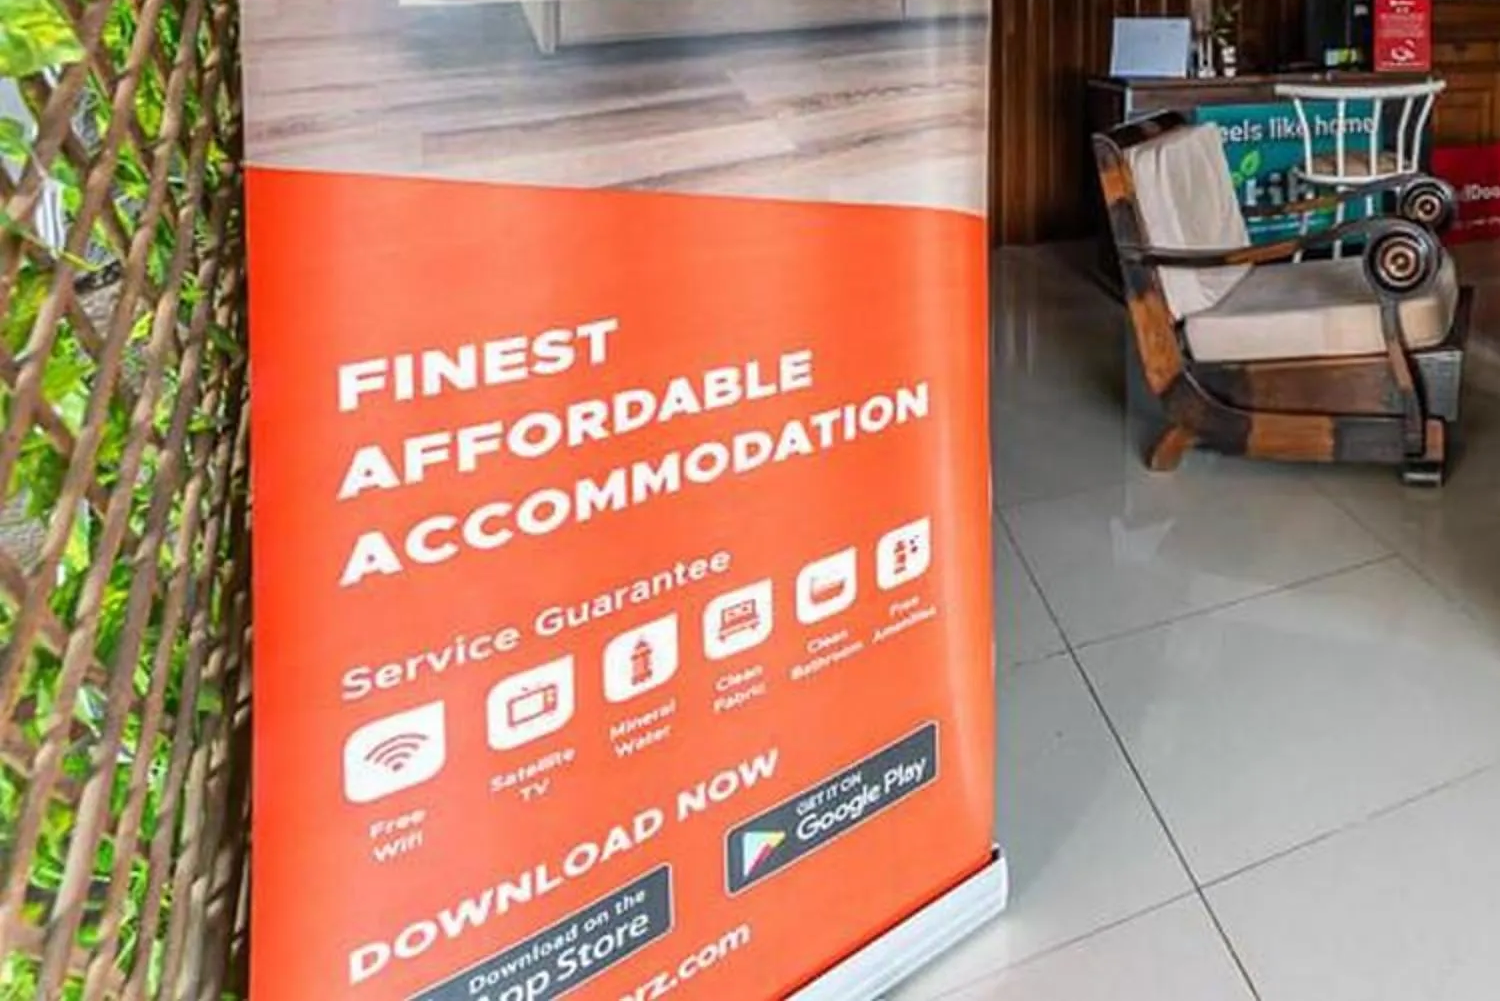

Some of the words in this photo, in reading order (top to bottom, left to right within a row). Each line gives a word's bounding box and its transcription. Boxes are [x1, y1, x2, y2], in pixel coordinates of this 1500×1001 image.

[1219, 118, 1263, 143] eels
[338, 318, 619, 412] FINEST
[336, 350, 814, 500] AFFORDABLE
[339, 381, 931, 587] ACCOMMODATION
[340, 621, 520, 702] Service
[534, 550, 732, 638] Guarantee
[713, 681, 767, 715] Fabric
[715, 663, 764, 693] Clean
[609, 696, 678, 743] Mineral
[613, 723, 673, 759] Water
[488, 746, 576, 794] Satellite
[519, 777, 550, 802] TV
[795, 788, 825, 816] GET
[839, 770, 864, 793] ON
[796, 784, 882, 841] Google
[883, 756, 927, 795] Play
[369, 808, 427, 840] Free
[372, 829, 425, 864] Wifi
[348, 808, 664, 985] DOWNLOAD
[676, 746, 779, 823] NOW
[468, 922, 579, 996] Download
[583, 910, 610, 934] on
[613, 888, 647, 917] the
[556, 912, 650, 983] Store
